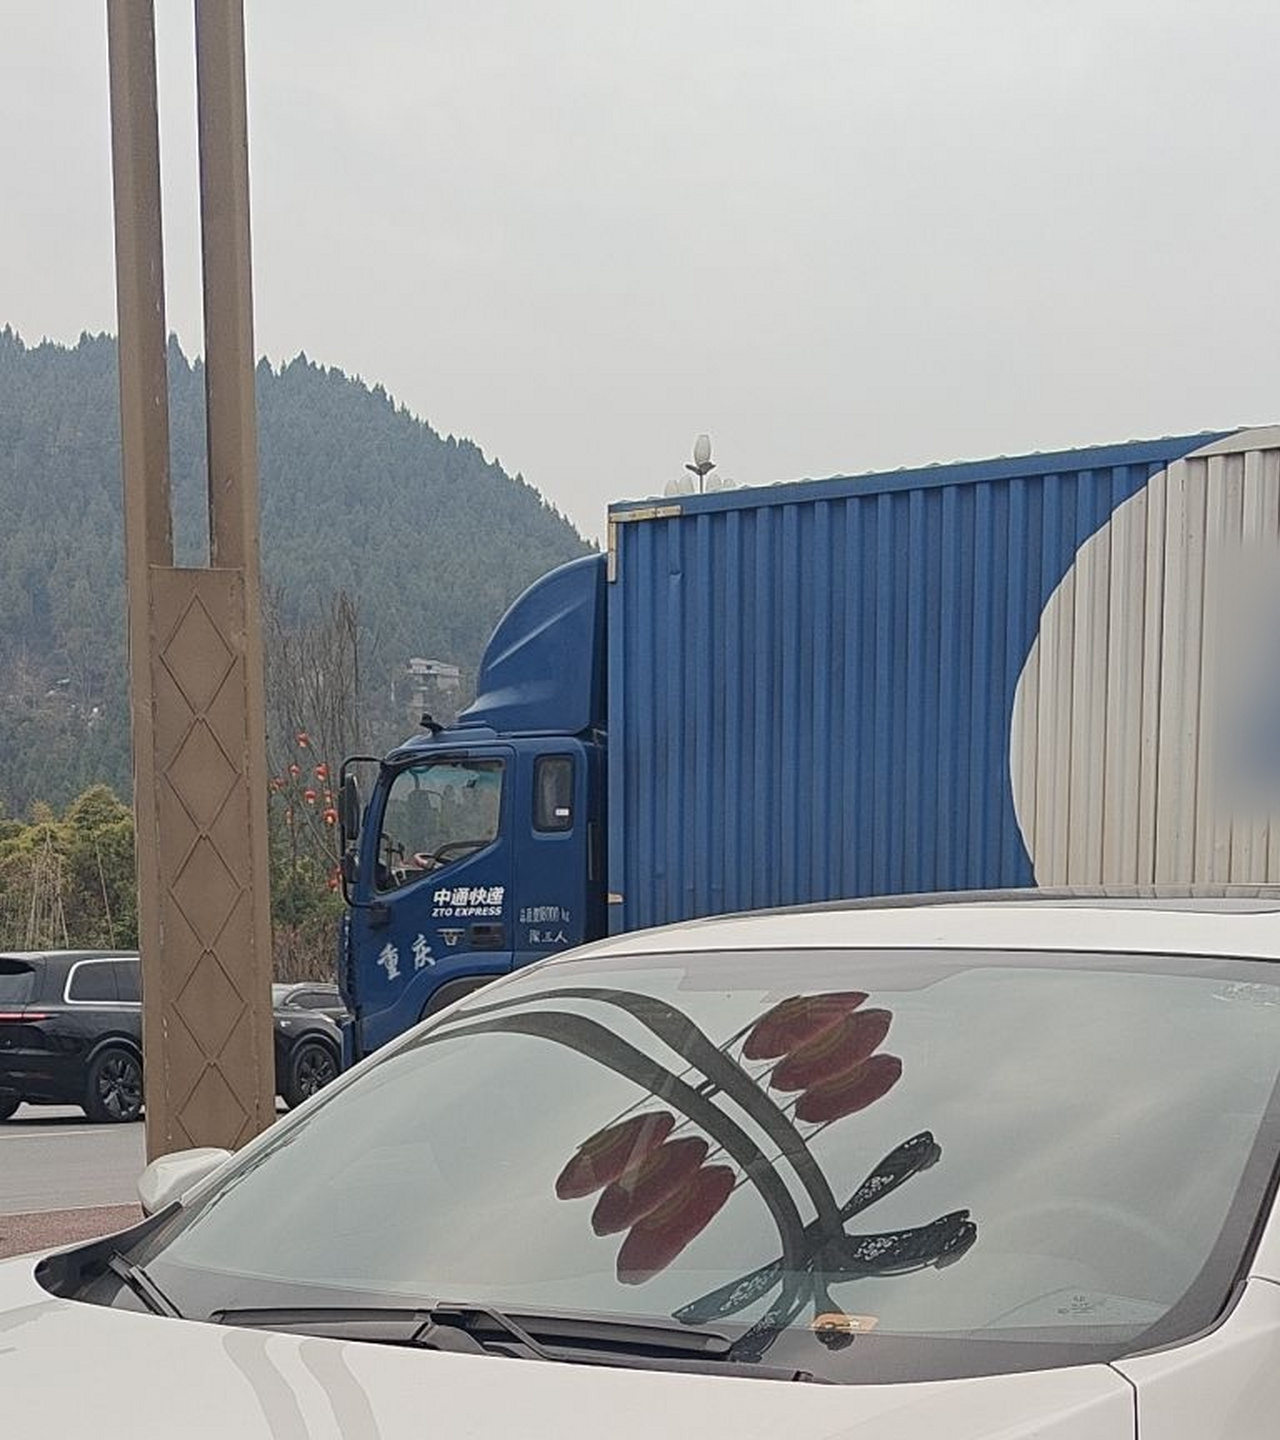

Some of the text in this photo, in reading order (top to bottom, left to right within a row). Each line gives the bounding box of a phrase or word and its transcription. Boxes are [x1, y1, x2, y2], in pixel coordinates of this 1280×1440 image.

[433, 886, 504, 906] 中通快递
[432, 907, 502, 918] ZTO EXPRESS
[377, 934, 436, 980] 重庆
